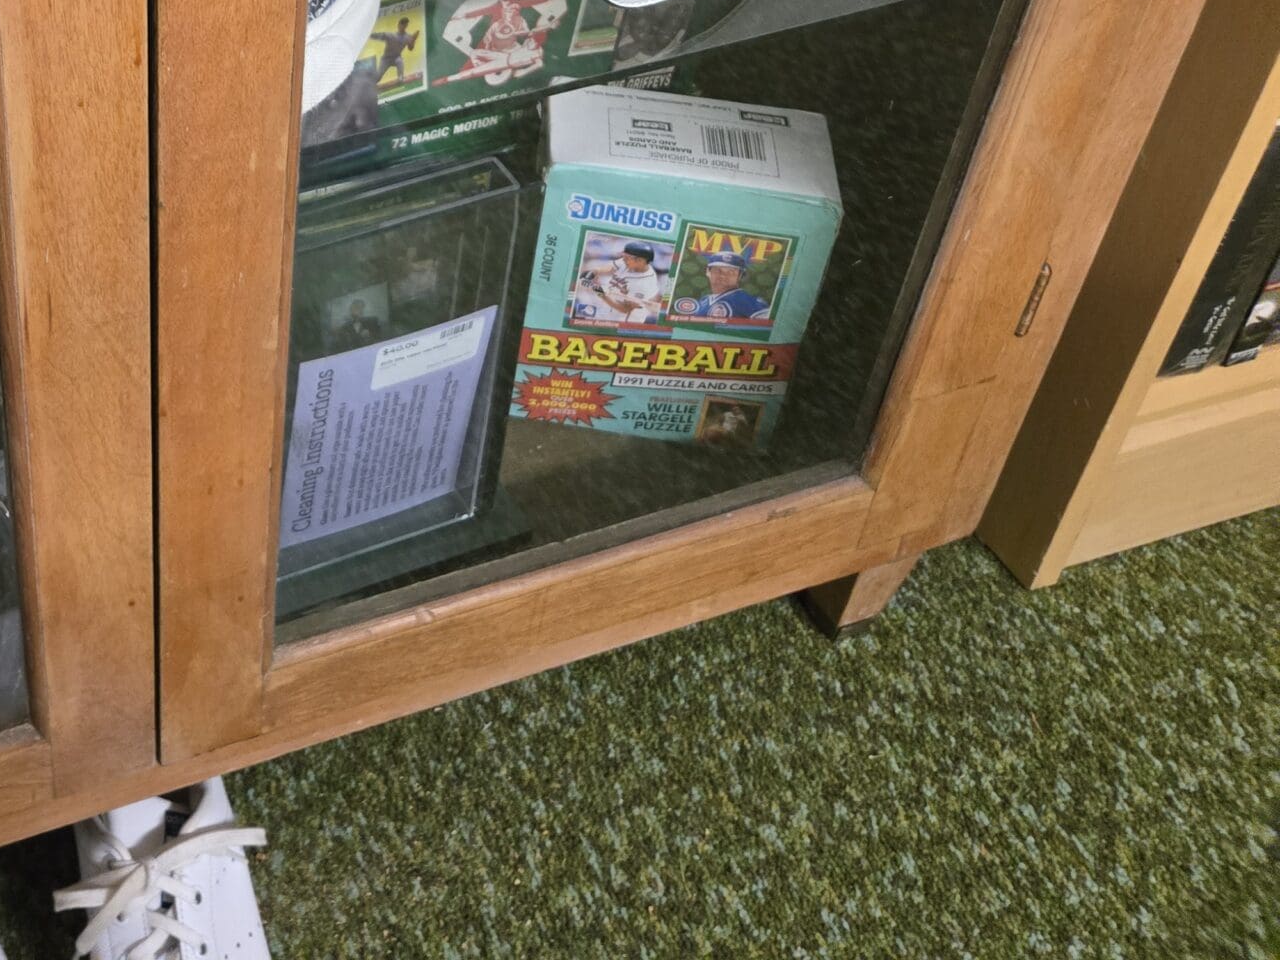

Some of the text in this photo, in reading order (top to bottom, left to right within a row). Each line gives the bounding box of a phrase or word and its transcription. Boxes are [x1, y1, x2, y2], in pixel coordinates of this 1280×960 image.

[392, 135, 408, 151] 72
[411, 126, 450, 145] MAGIC
[452, 113, 499, 135] MOTION
[696, 157, 709, 166] OF
[710, 159, 740, 170] PROOF
[568, 196, 673, 231] DONRUSS
[688, 227, 783, 261] MVP
[538, 233, 558, 283] 36 COUNT
[382, 340, 420, 357] $40.00
[526, 333, 775, 376] BASEBALL
[550, 379, 573, 389] WIN
[618, 375, 774, 393] 1991 PUZZLE AND CARDS
[532, 386, 591, 399] INSTANTLY!
[528, 398, 597, 411] 2,000,000
[647, 402, 697, 415] WILLIE
[622, 410, 695, 424] STARGELL
[632, 421, 693, 433] PUZZLE
[292, 367, 335, 534] Cleaning Instructions
